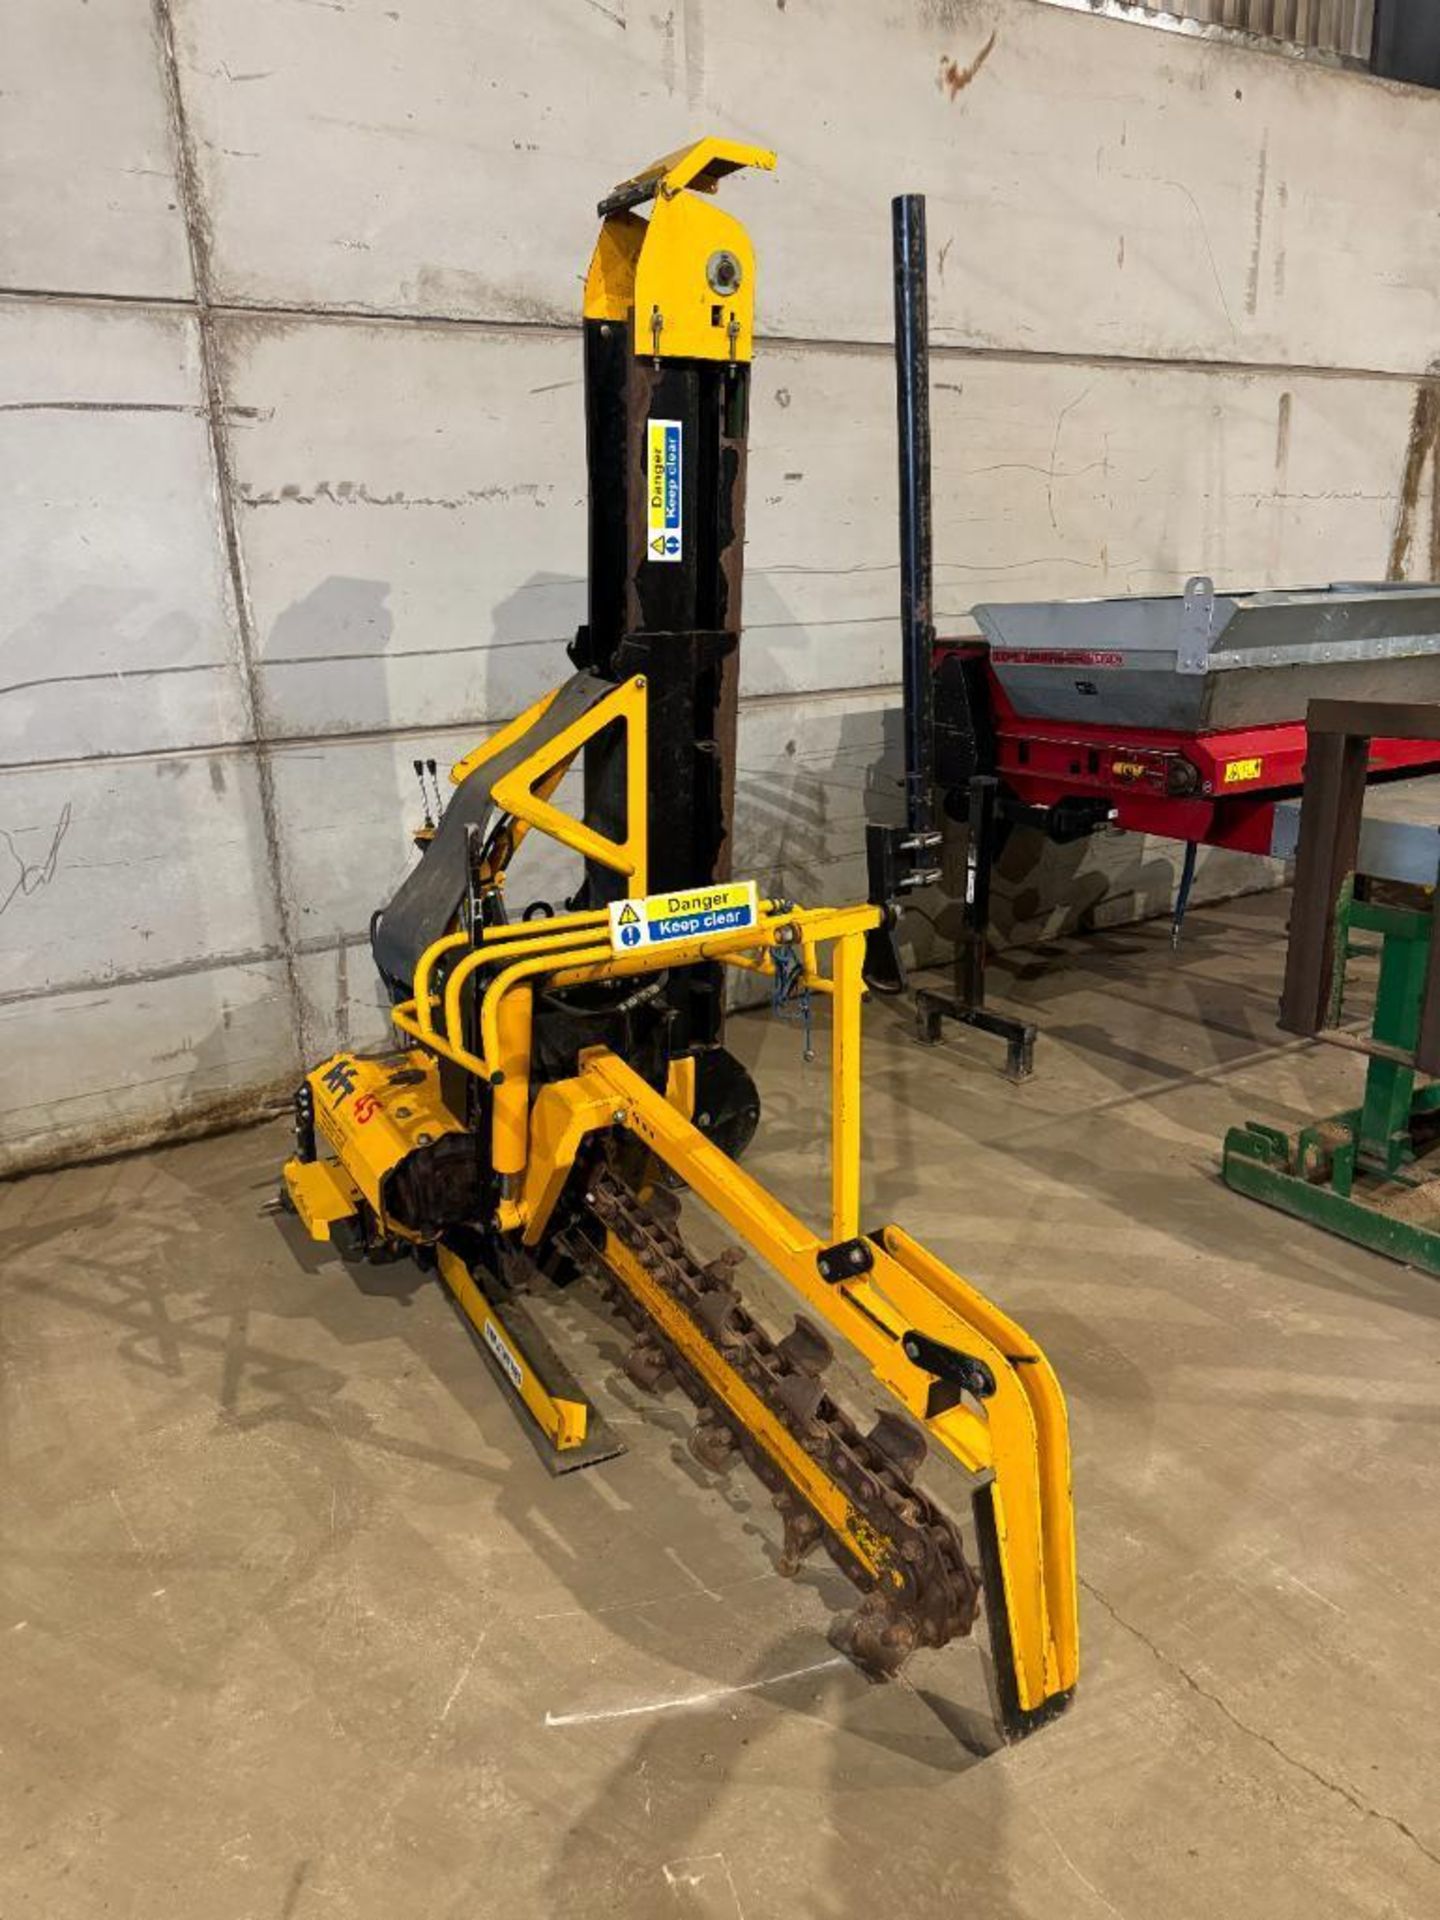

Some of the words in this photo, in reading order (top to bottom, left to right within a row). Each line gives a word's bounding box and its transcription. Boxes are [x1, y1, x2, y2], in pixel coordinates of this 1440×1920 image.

[666, 437, 676, 476] clear
[652, 448, 664, 508] Danger
[666, 479, 678, 518] Keep
[668, 893, 729, 913] Danger
[660, 920, 700, 935] Keep
[703, 911, 741, 927] clear
